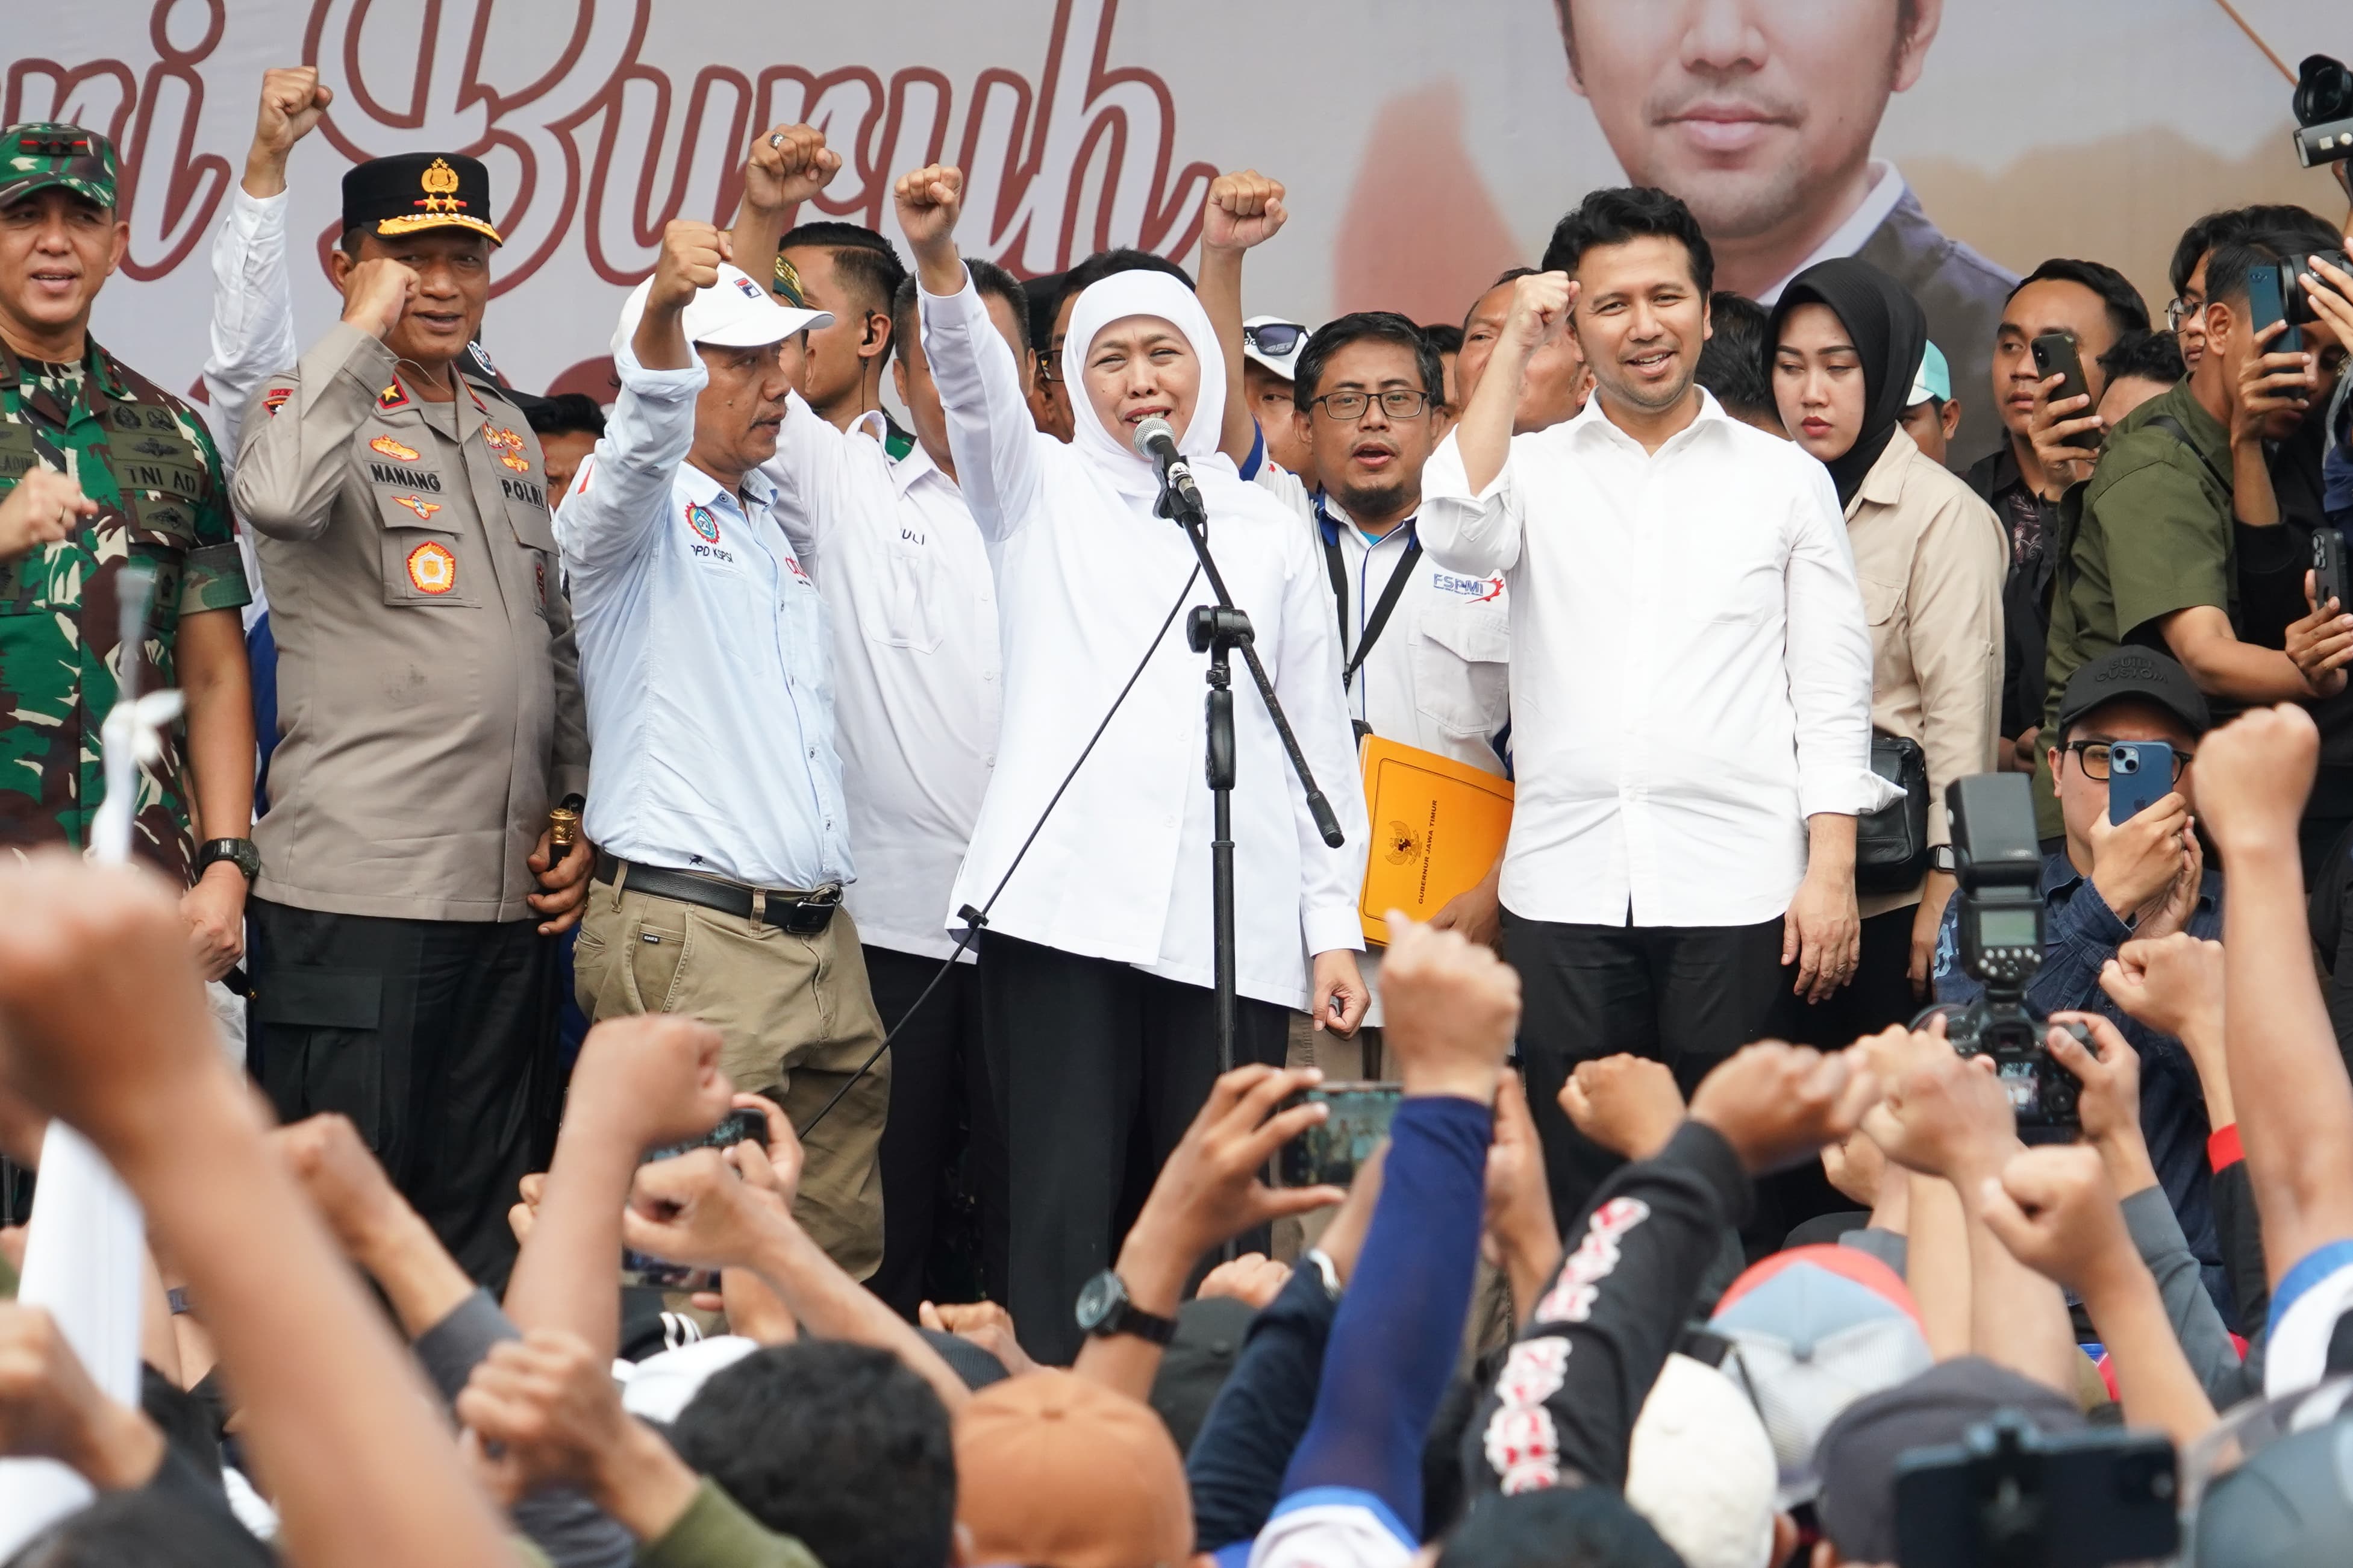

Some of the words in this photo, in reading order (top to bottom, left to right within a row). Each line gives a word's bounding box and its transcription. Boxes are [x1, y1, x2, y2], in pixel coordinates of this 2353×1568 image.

[303, 0, 1220, 301] Buruh
[124, 464, 163, 486] TNI
[173, 470, 196, 493] AD
[370, 463, 441, 492] NANANG
[501, 479, 545, 508] POLRI
[1434, 573, 1483, 594] FSPMI
[1429, 799, 1437, 827] TIMUR
[1425, 829, 1434, 854] JAWA
[1418, 856, 1430, 904] GUBERNUR
